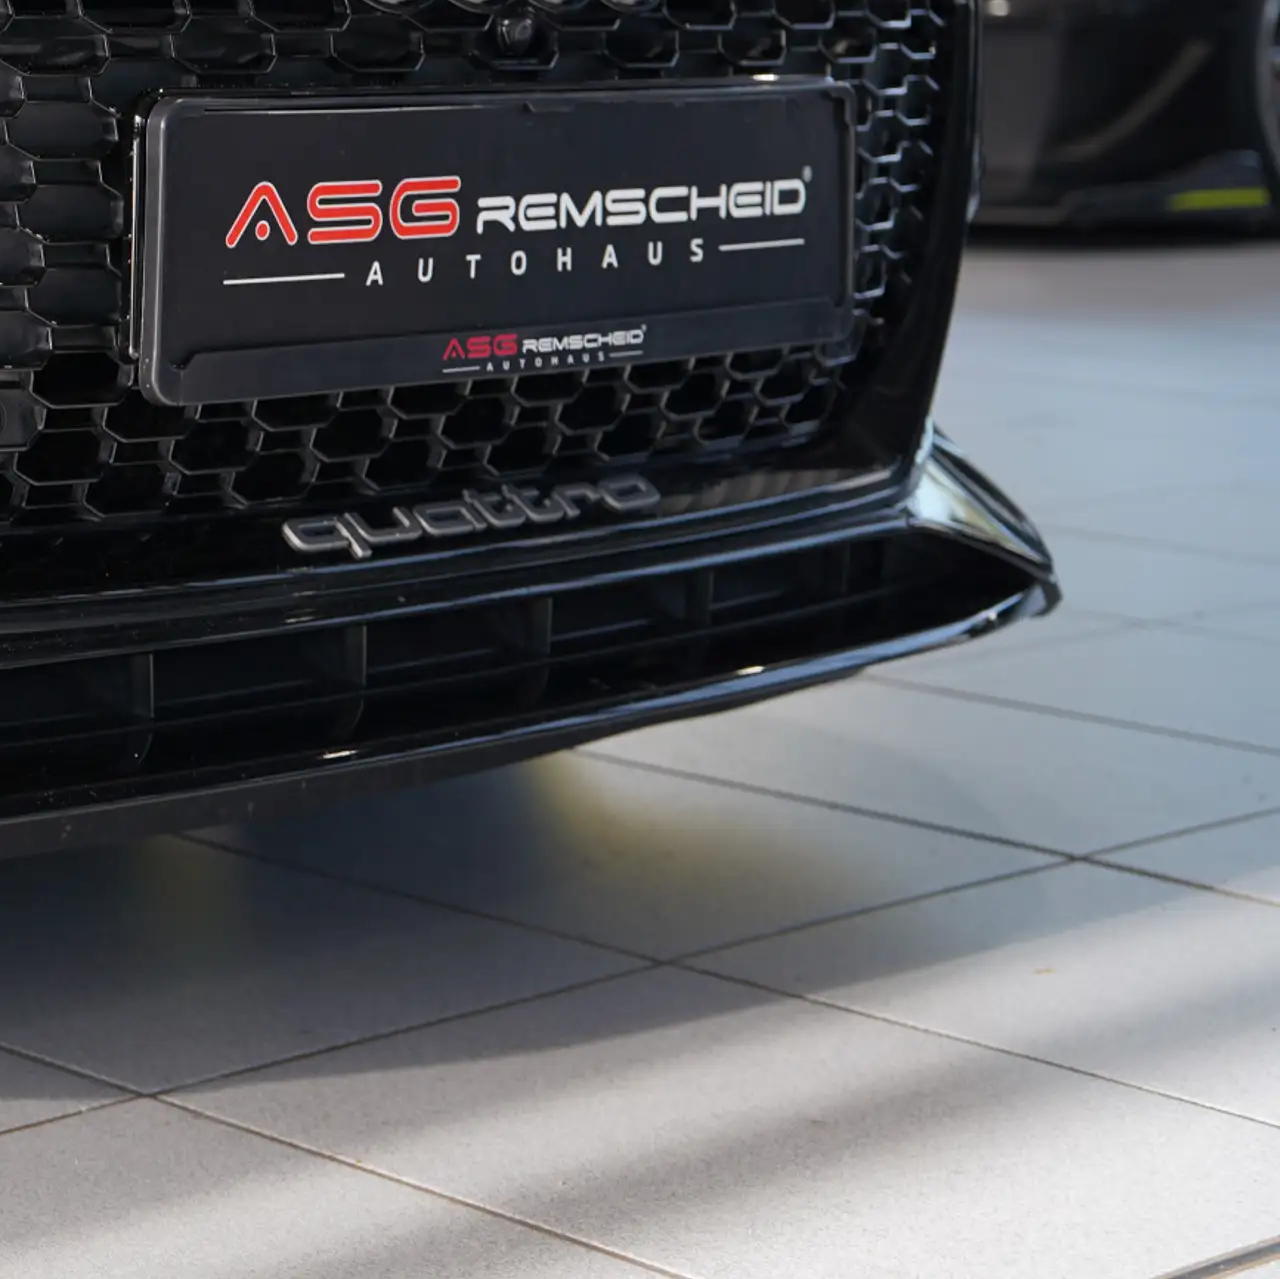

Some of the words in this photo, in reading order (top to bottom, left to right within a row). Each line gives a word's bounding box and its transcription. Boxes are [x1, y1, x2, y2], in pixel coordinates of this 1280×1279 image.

[225, 176, 461, 248] ASG
[365, 238, 705, 287] AUTOHAUS
[443, 333, 518, 361] ASG
[486, 351, 605, 373] AUTOHAUS
[281, 474, 661, 559] quattro
